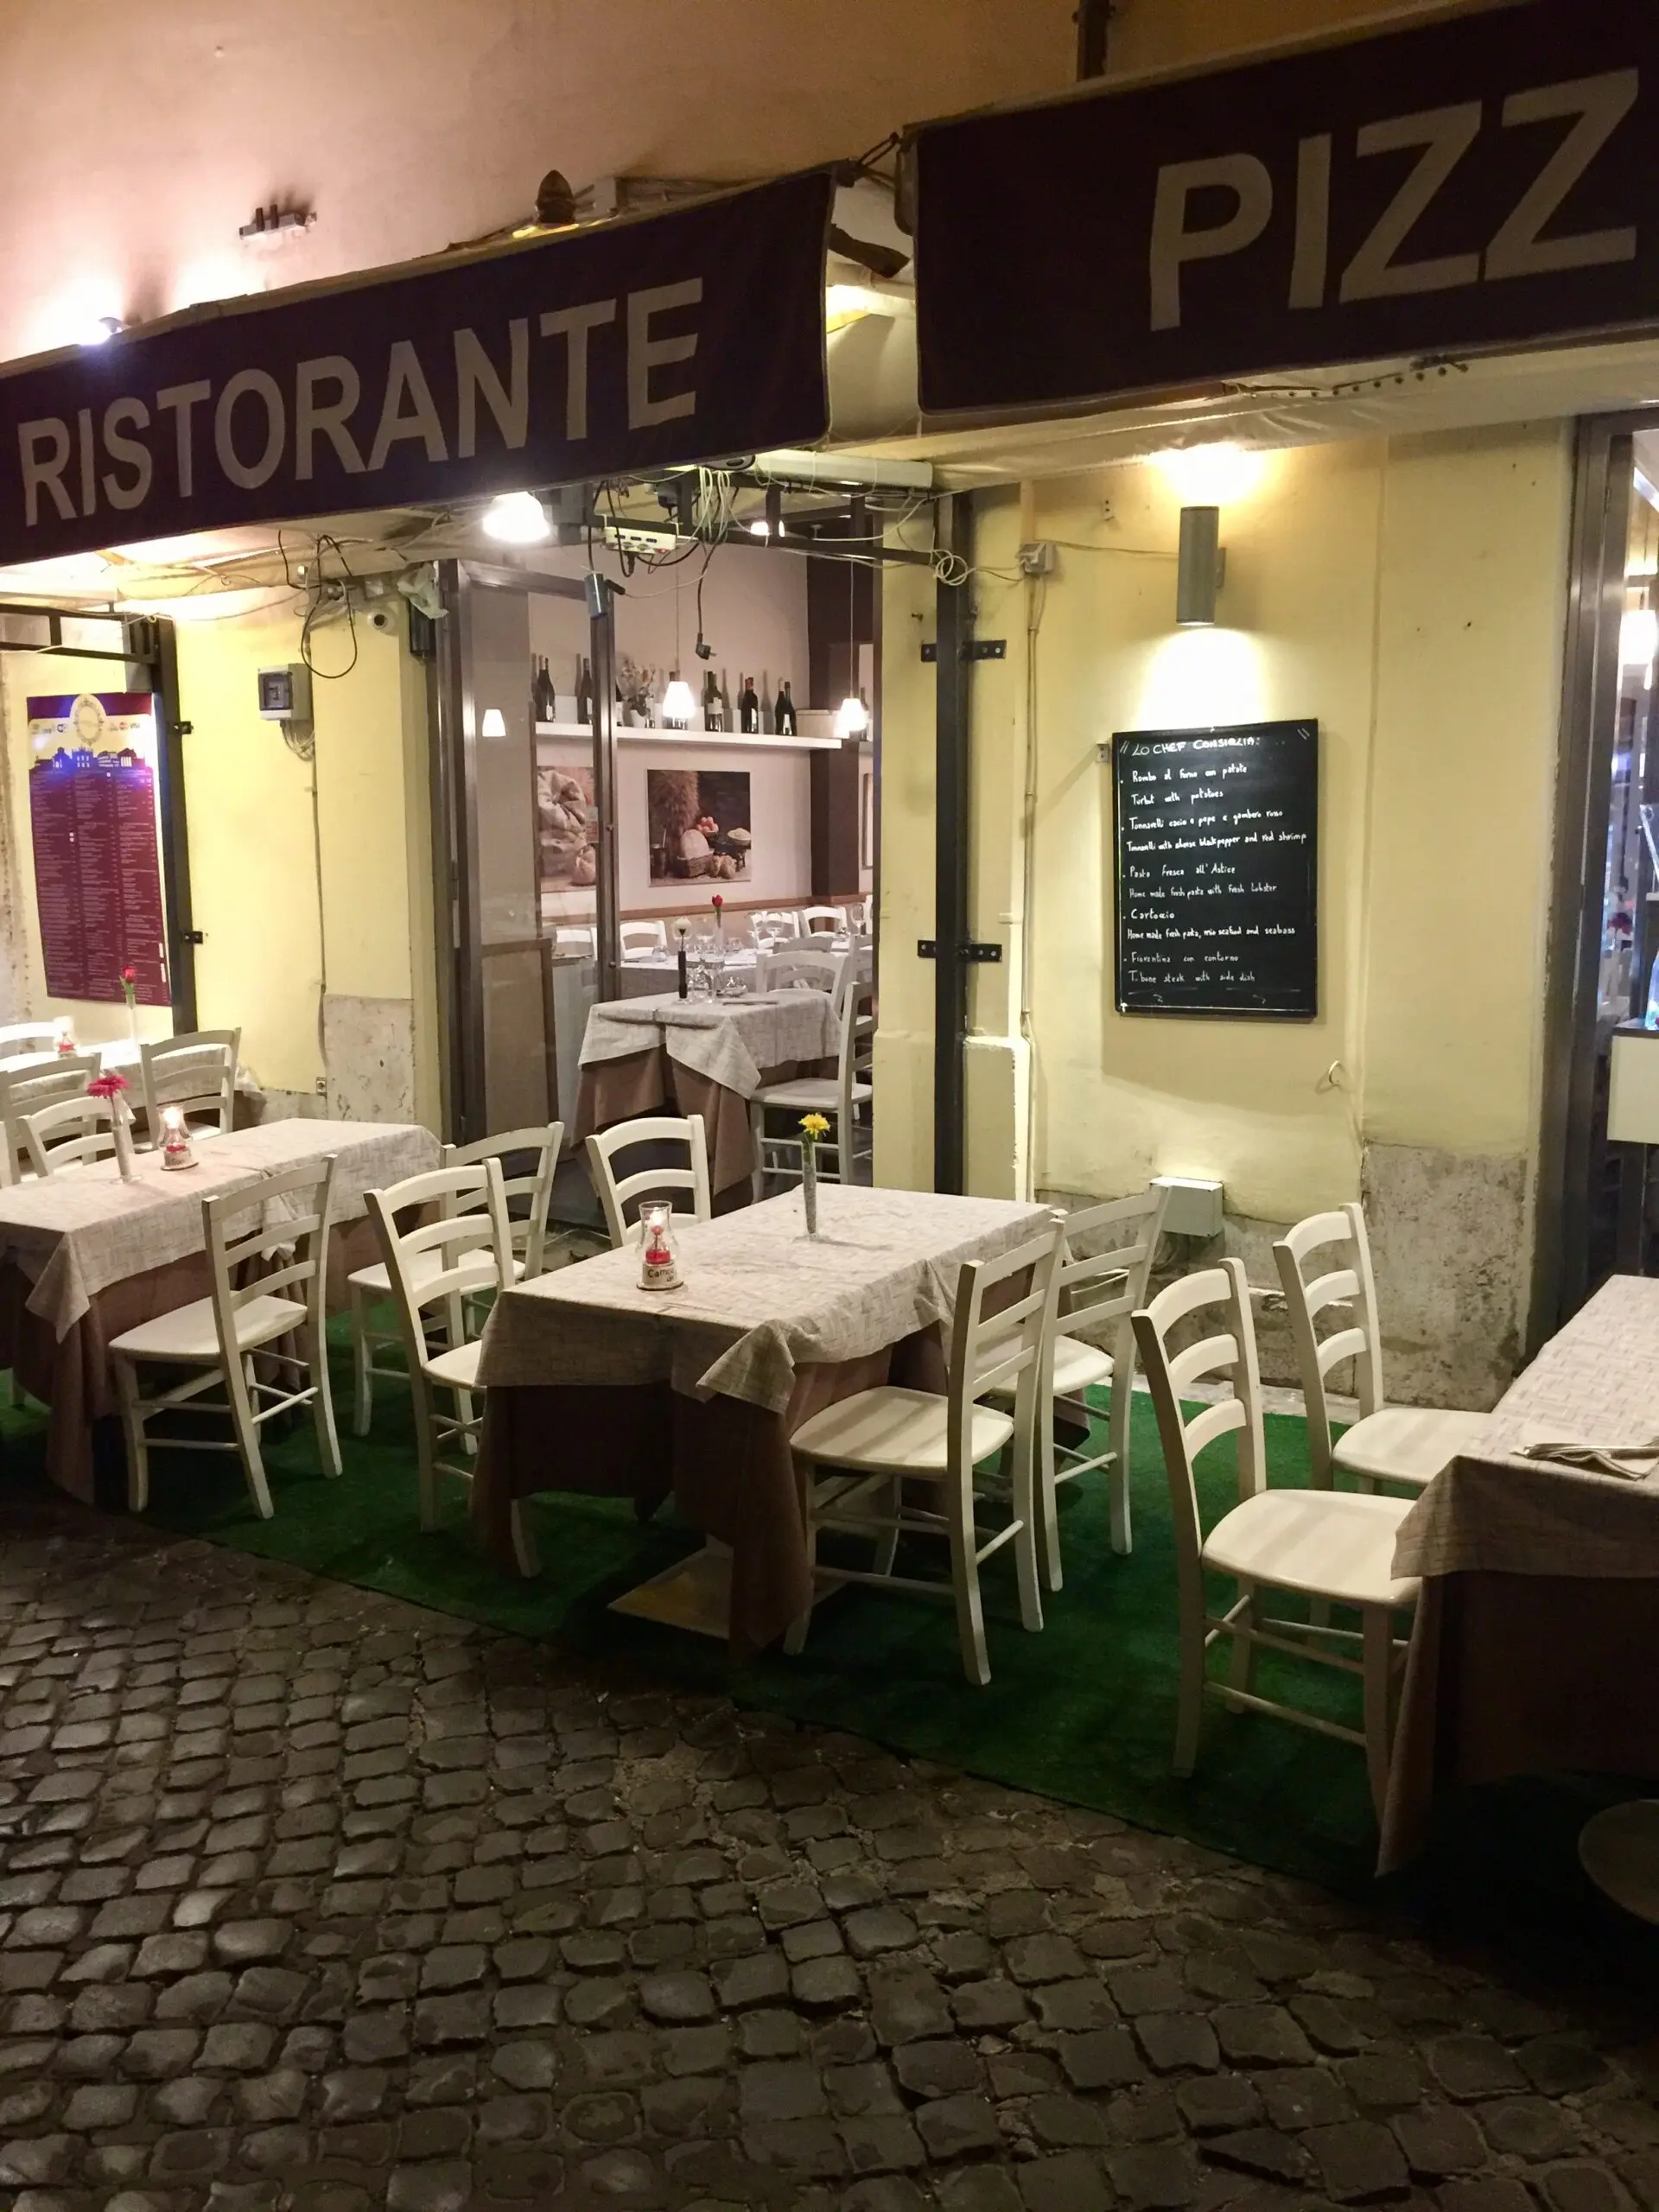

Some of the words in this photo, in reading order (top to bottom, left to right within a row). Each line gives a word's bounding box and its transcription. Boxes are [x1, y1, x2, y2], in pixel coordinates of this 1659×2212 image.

[1150, 68, 1639, 331] PIZZ
[17, 277, 702, 526] RISTORANTE
[1132, 747, 1150, 756] LO
[1154, 741, 1188, 754] CHEF
[1133, 771, 1156, 782] Rombo
[1164, 769, 1172, 780] al
[1223, 763, 1248, 779] patate
[1131, 794, 1154, 805] Turbot
[1165, 792, 1180, 803] with
[1191, 788, 1224, 804] potatoes
[1169, 818, 1187, 827] cacio
[1198, 815, 1215, 827] pepe
[1233, 809, 1262, 824] gambero
[1158, 842, 1172, 850] with
[1244, 832, 1257, 843] and
[1262, 831, 1274, 842] red
[1279, 831, 1306, 844] shrimp
[1130, 866, 1150, 878] Pasta
[1129, 888, 1146, 898] Home
[1150, 887, 1165, 898] made
[1187, 887, 1203, 899] pasta
[1207, 884, 1222, 895] with
[1127, 928, 1143, 938] Home
[1147, 929, 1162, 939] made
[1246, 925, 1259, 935] and
[1265, 925, 1295, 934] seabass
[1132, 951, 1171, 963] Fiorentina
[1205, 951, 1238, 962] contorno
[1164, 970, 1185, 982] steak
[1195, 970, 1210, 982] with
[1219, 970, 1234, 981] side
[1240, 971, 1255, 982] dish
